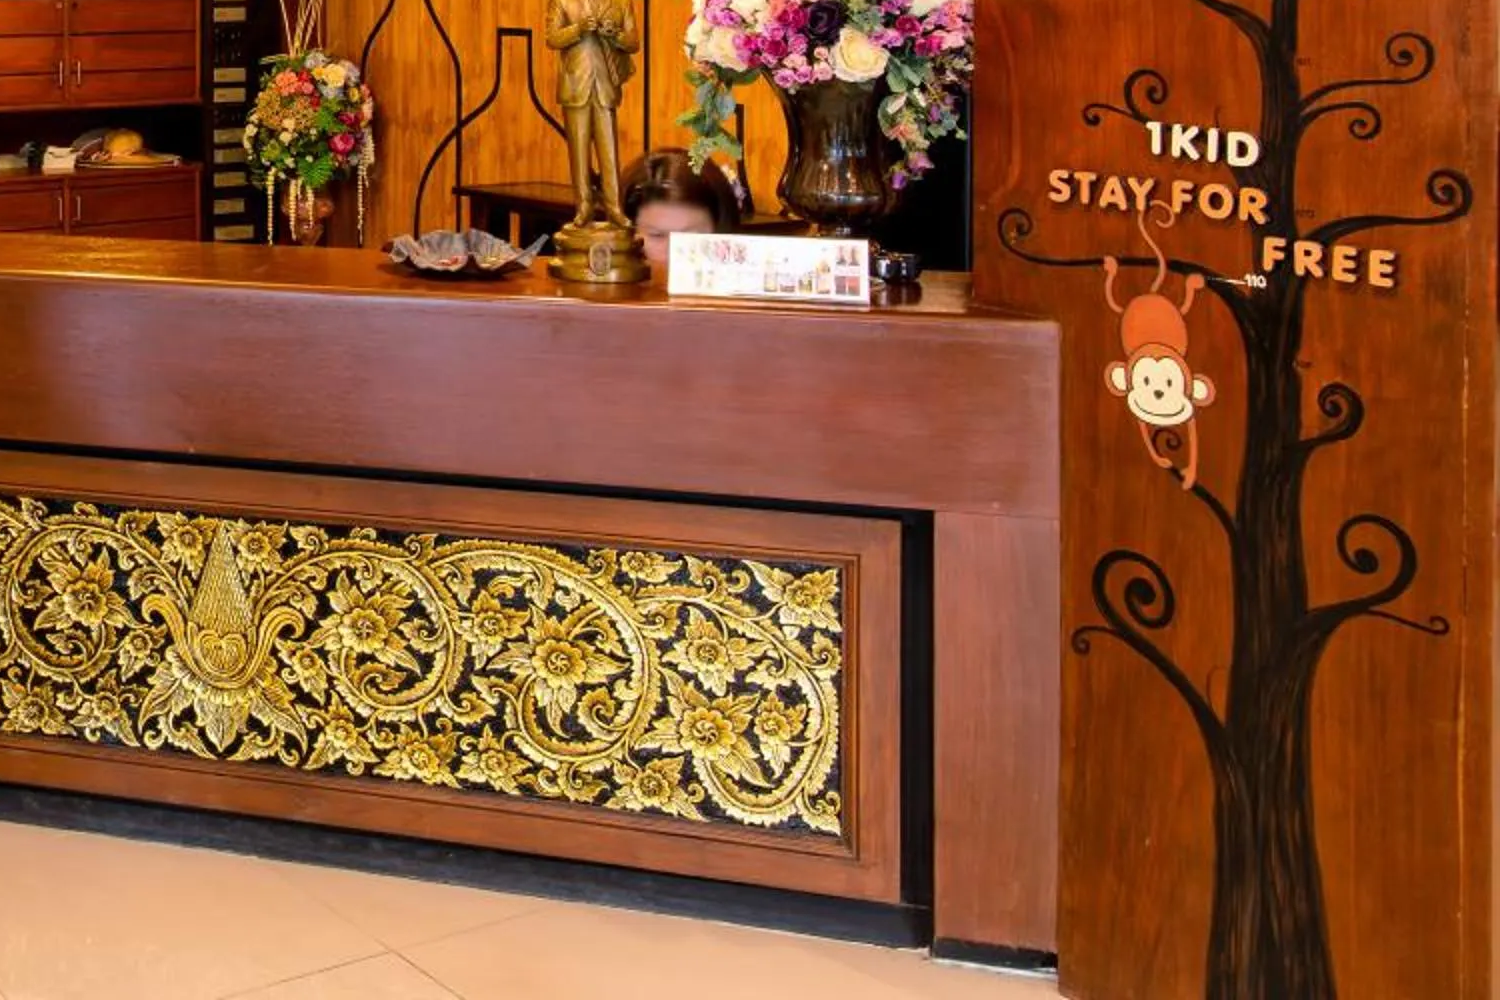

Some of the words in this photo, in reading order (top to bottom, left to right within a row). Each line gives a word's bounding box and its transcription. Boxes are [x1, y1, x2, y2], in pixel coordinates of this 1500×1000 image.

[1048, 169, 1155, 211] STAY
[1170, 179, 1268, 225] FOR
[1243, 273, 1268, 288] 110
[1262, 236, 1395, 288] FREE
